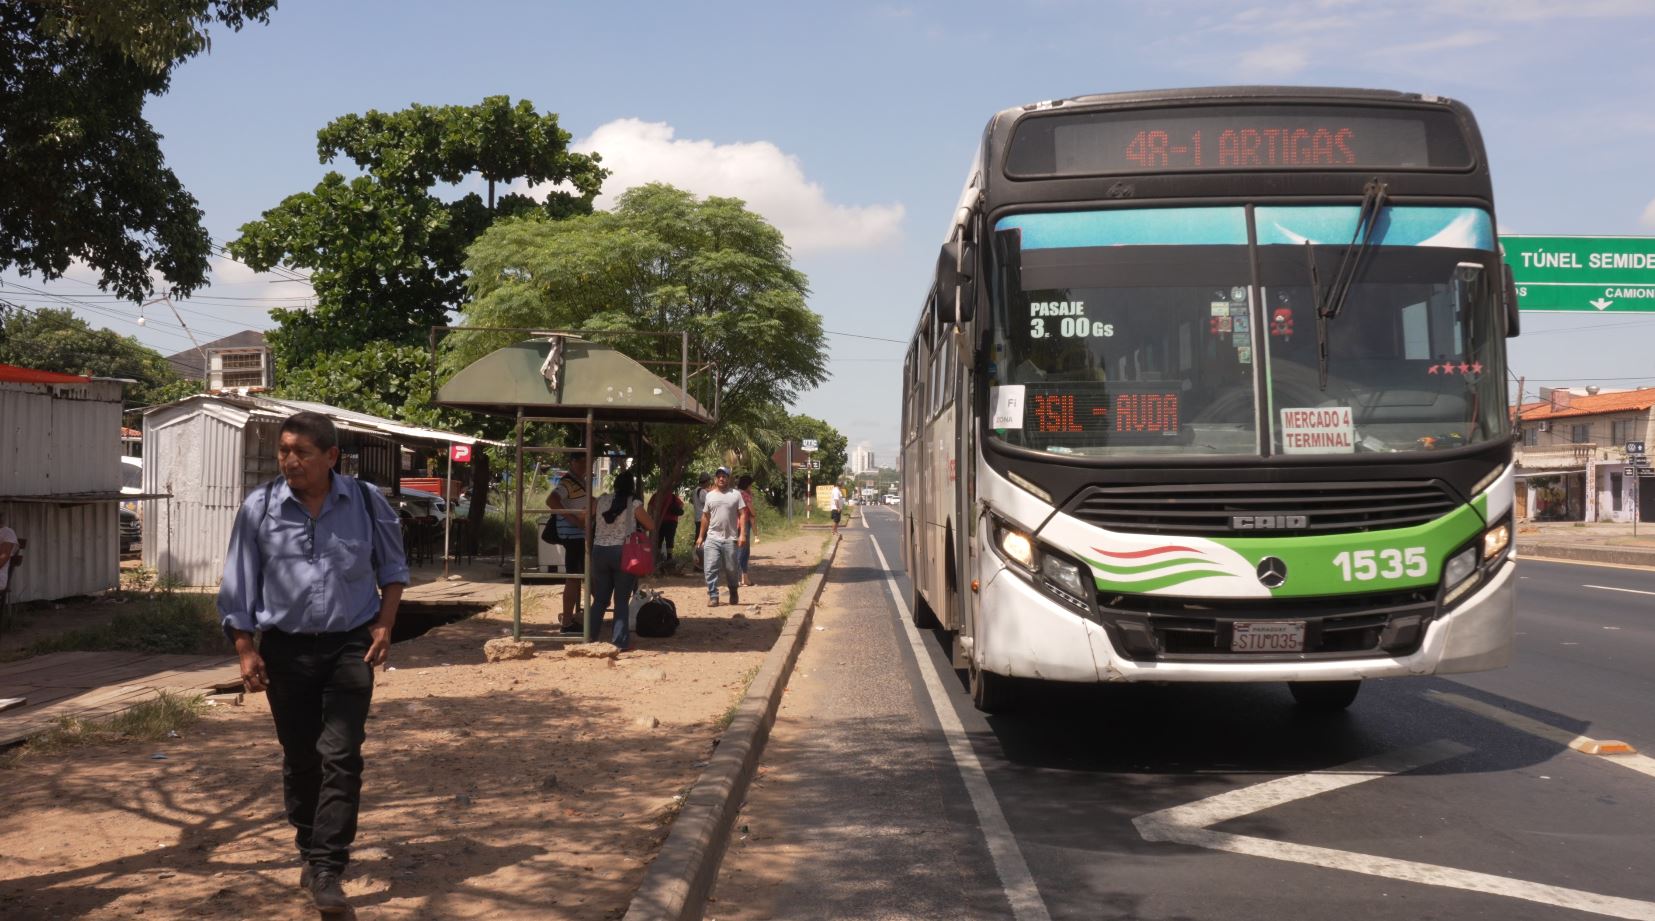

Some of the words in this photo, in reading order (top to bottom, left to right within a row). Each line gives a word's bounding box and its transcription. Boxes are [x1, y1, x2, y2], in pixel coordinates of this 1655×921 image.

[1126, 129, 1201, 167] 4R-1
[1218, 127, 1356, 167] ARTIGAS
[1521, 248, 1582, 268] TÚNEL
[1588, 253, 1655, 269] SEMIDE
[1605, 288, 1655, 298] CAMION
[1030, 301, 1084, 317] PASAJE
[1116, 394, 1177, 432] AVDA
[1284, 410, 1340, 428] MERCADO
[1343, 409, 1350, 427] 4
[1286, 432, 1351, 448] TERMINAL
[1332, 546, 1428, 581] 1535
